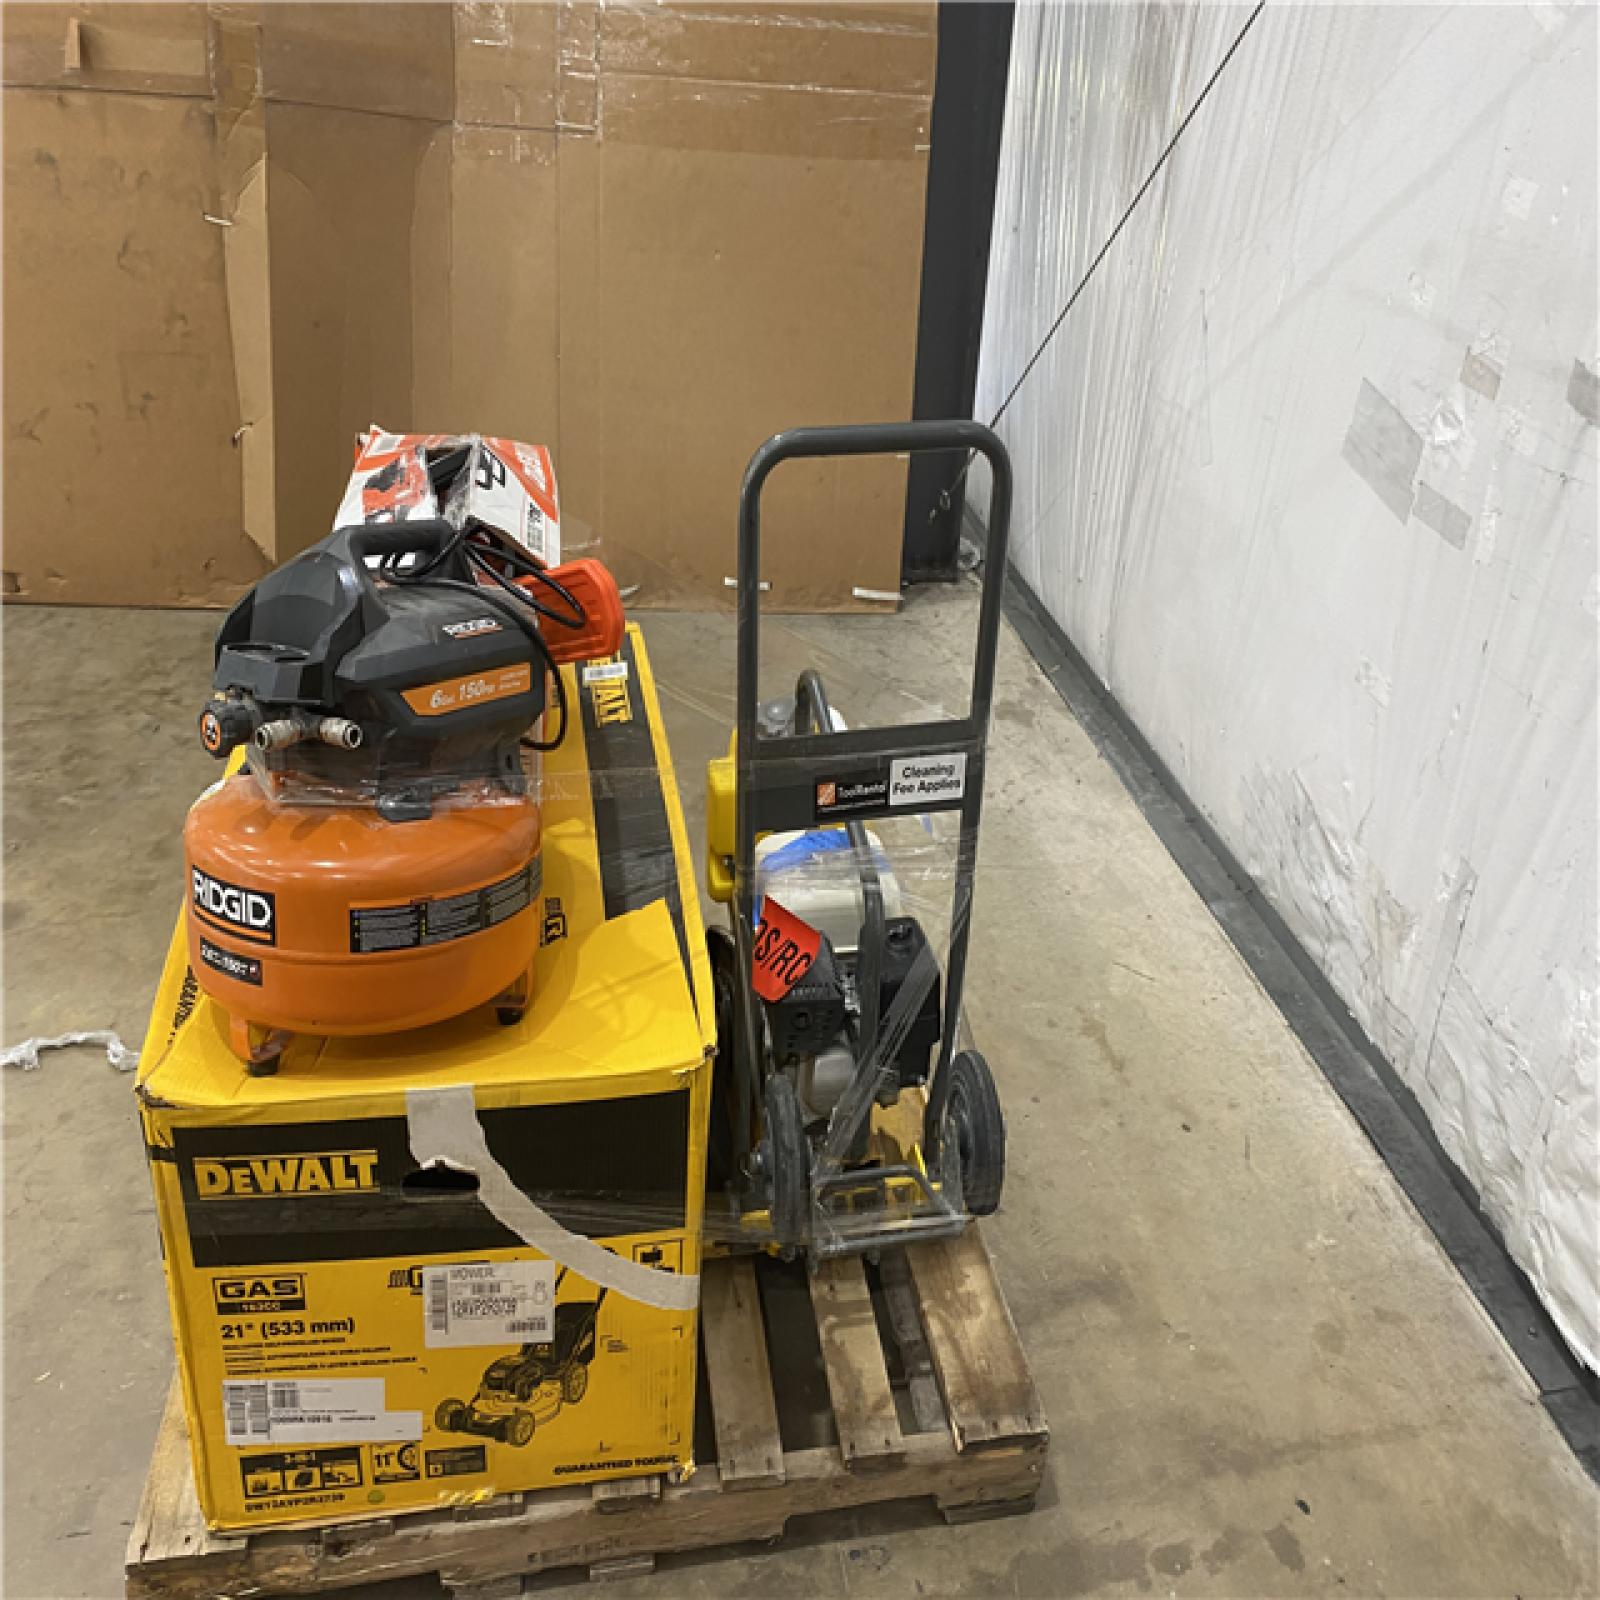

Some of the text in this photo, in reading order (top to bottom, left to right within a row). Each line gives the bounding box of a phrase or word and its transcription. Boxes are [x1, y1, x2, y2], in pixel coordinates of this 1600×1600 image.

[902, 763, 956, 779] Cleaning
[893, 778, 961, 796] Fee Applies
[191, 868, 272, 926] RIDGID
[220, 1279, 298, 1298] GAS
[260, 1318, 305, 1340] (533
[310, 1316, 355, 1334] mm)
